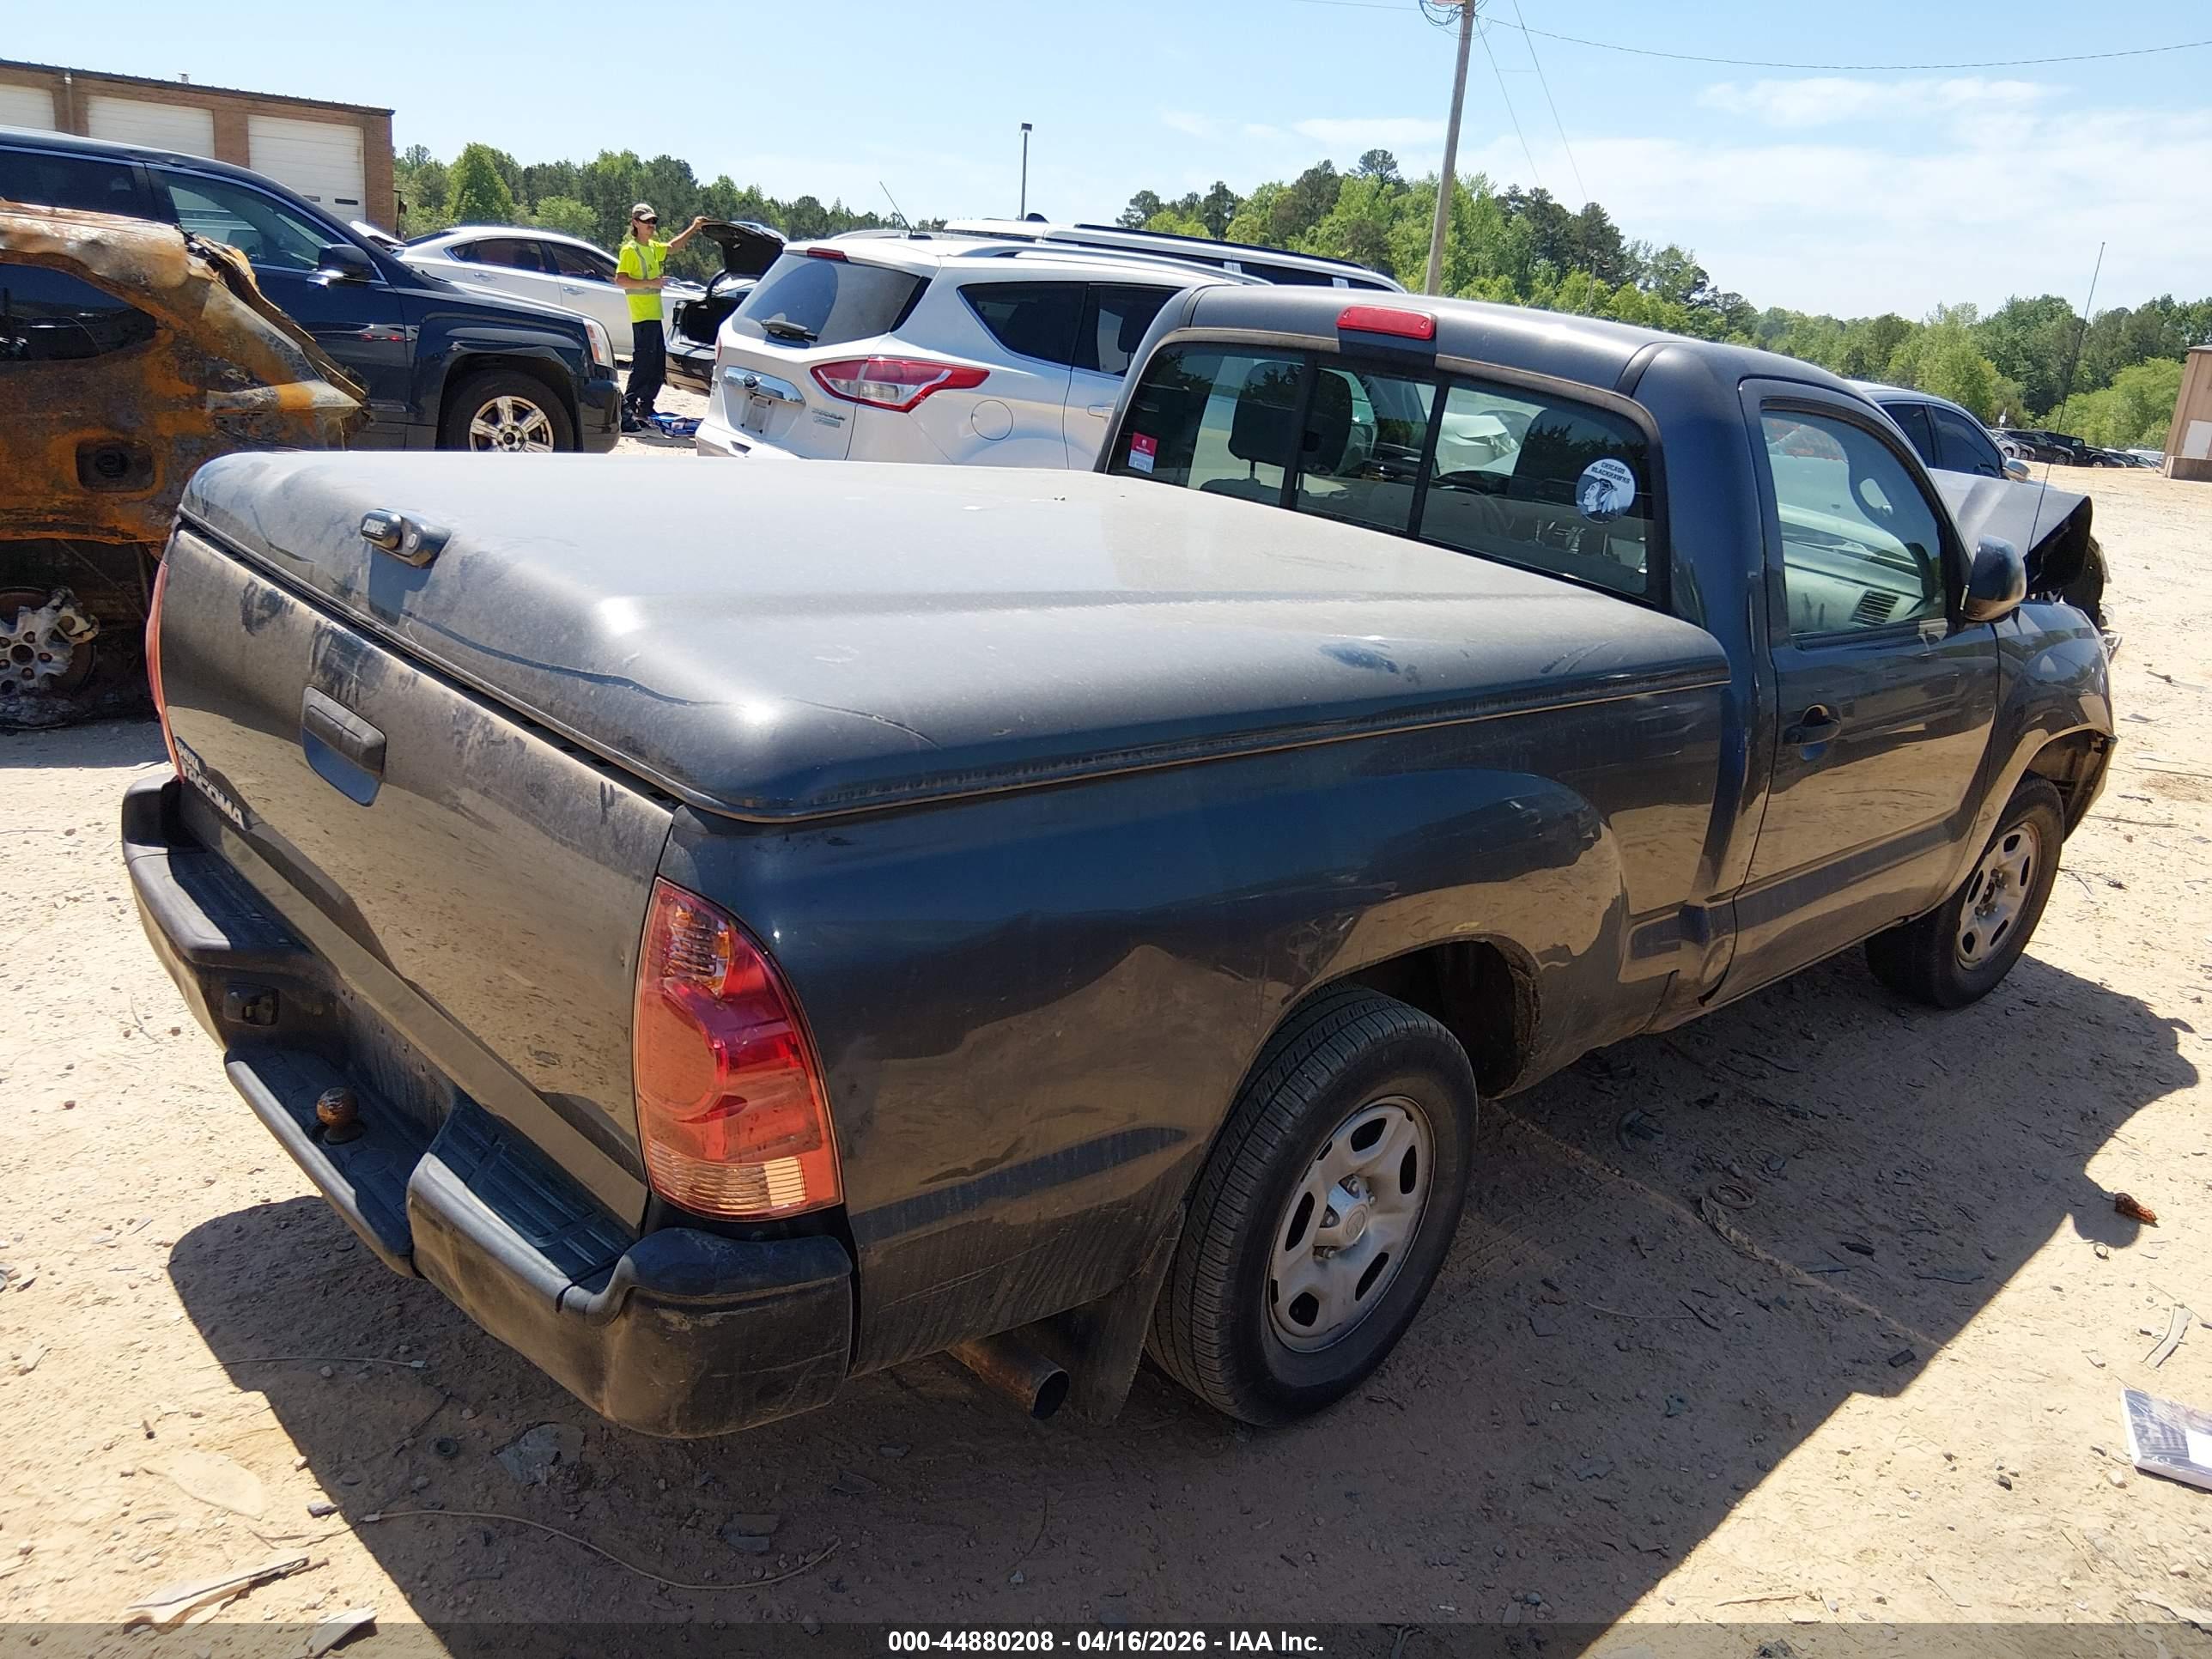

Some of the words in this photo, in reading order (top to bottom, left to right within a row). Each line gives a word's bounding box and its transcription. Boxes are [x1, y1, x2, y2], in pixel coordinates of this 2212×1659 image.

[1591, 466, 1631, 484] BLACKHAWKS
[1601, 461, 1626, 474] CHICAGO
[178, 756, 247, 831] TACOMA
